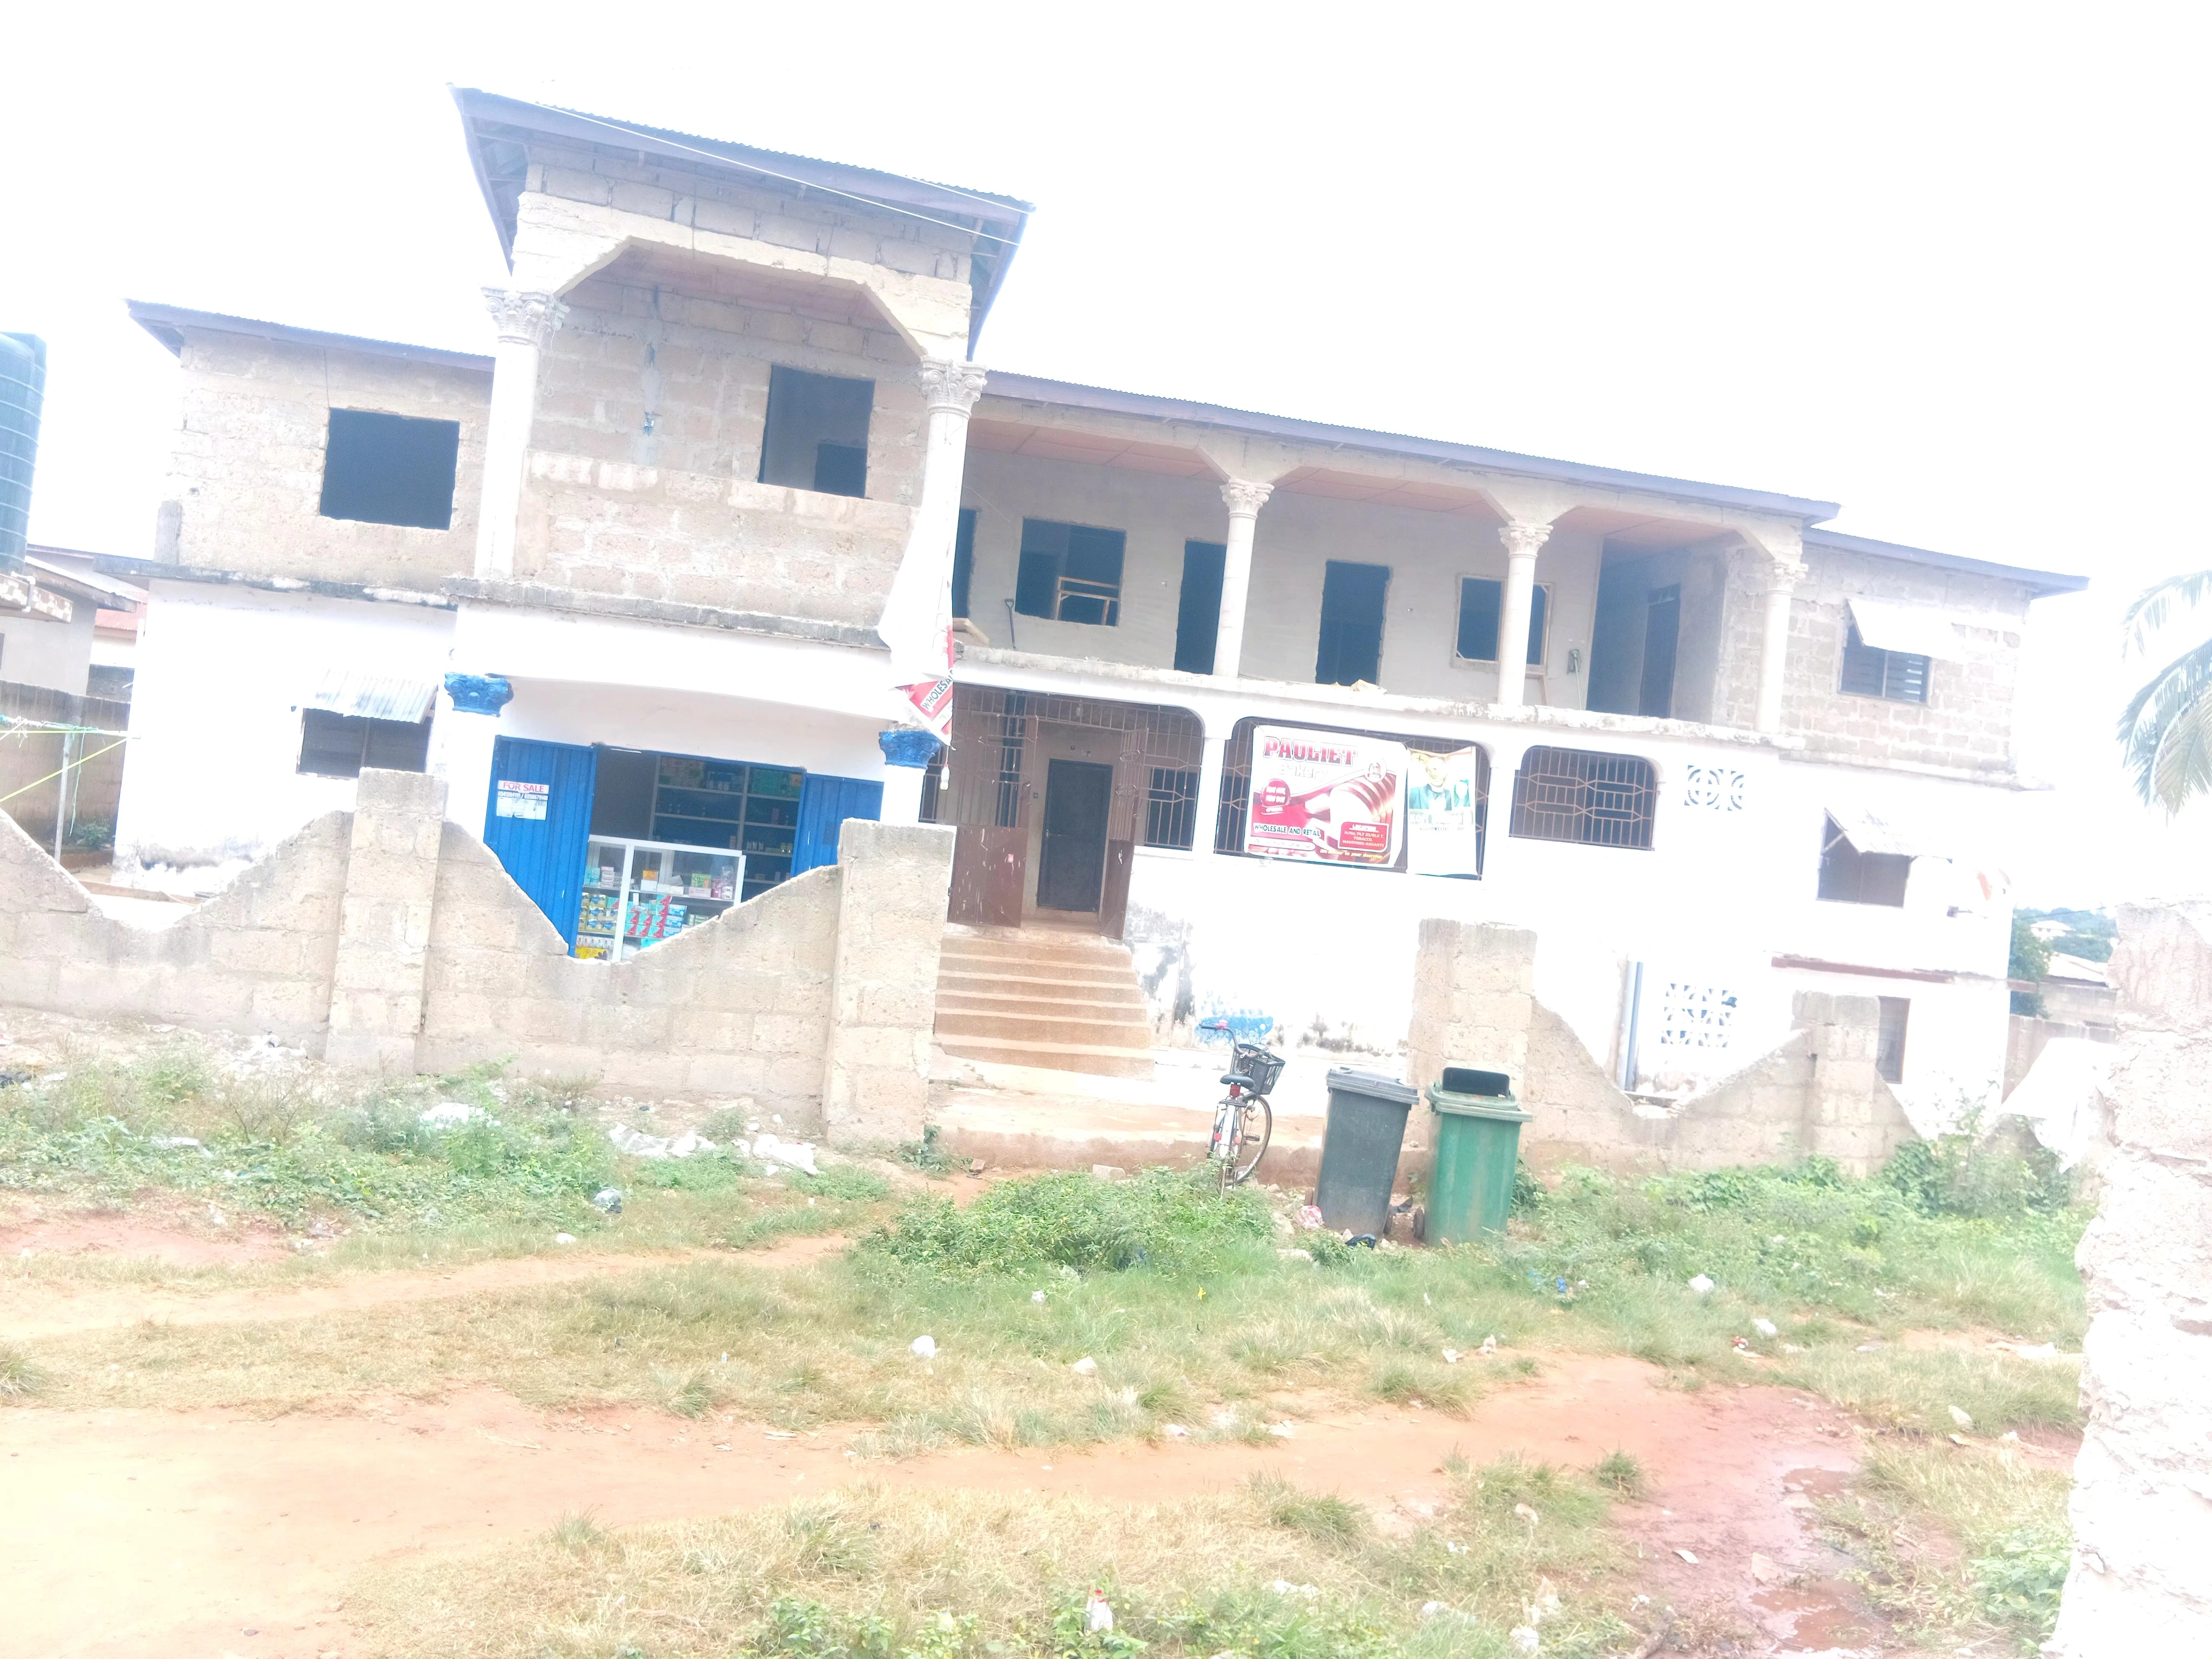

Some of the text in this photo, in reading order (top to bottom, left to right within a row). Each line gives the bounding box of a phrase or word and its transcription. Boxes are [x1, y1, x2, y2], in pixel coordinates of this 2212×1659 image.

[1263, 736, 1358, 767] PAULIET
[1279, 763, 1328, 782] Bakery
[503, 781, 544, 793] FOR SALE
[1255, 825, 1286, 833] WHOLESALE
